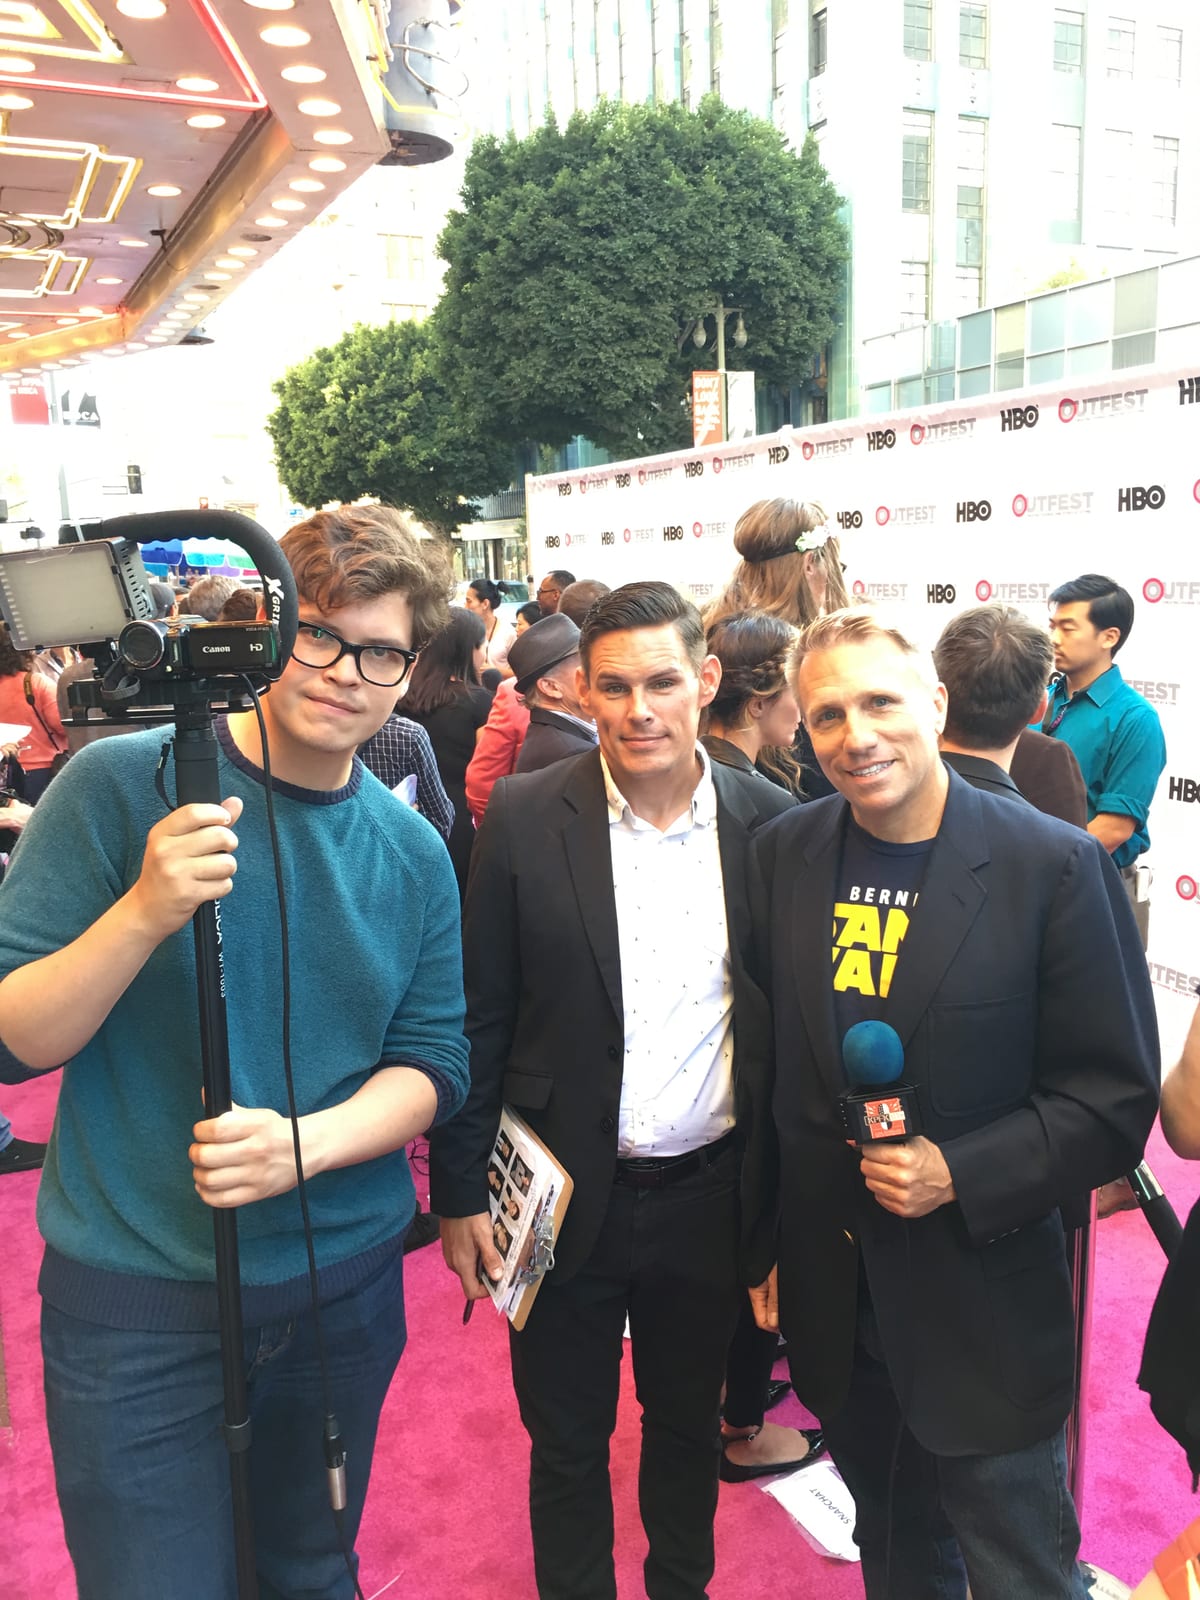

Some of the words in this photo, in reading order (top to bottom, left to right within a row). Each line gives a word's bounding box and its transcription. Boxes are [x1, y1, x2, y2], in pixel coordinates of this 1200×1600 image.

[1058, 389, 1148, 423] OUTFEST
[1000, 405, 1038, 432] HBO
[867, 429, 897, 451] HBO
[910, 418, 977, 445] OUTFEST
[768, 446, 790, 465] HBO
[802, 438, 854, 460] OUTFEST
[684, 461, 704, 478] HBO
[713, 454, 755, 473] OUTFEST
[615, 473, 631, 488] HBO
[638, 468, 673, 485] OUTFEST
[1012, 492, 1094, 517] OUTFEST
[1118, 485, 1165, 512] HBO
[836, 510, 863, 529] HBO
[875, 505, 937, 526] OUTFEST
[956, 500, 992, 523] HBO
[545, 536, 560, 548] HBO
[601, 532, 615, 545] HBO
[663, 526, 683, 541] HBO
[852, 580, 908, 598] OUTFEST
[927, 584, 956, 604] HBO
[976, 580, 1050, 601] OUTFEST
[202, 645, 231, 654] Canon
[249, 643, 264, 652] HD
[1169, 776, 1200, 804] HB
[809, 1488, 852, 1524] SNAPCHAT
